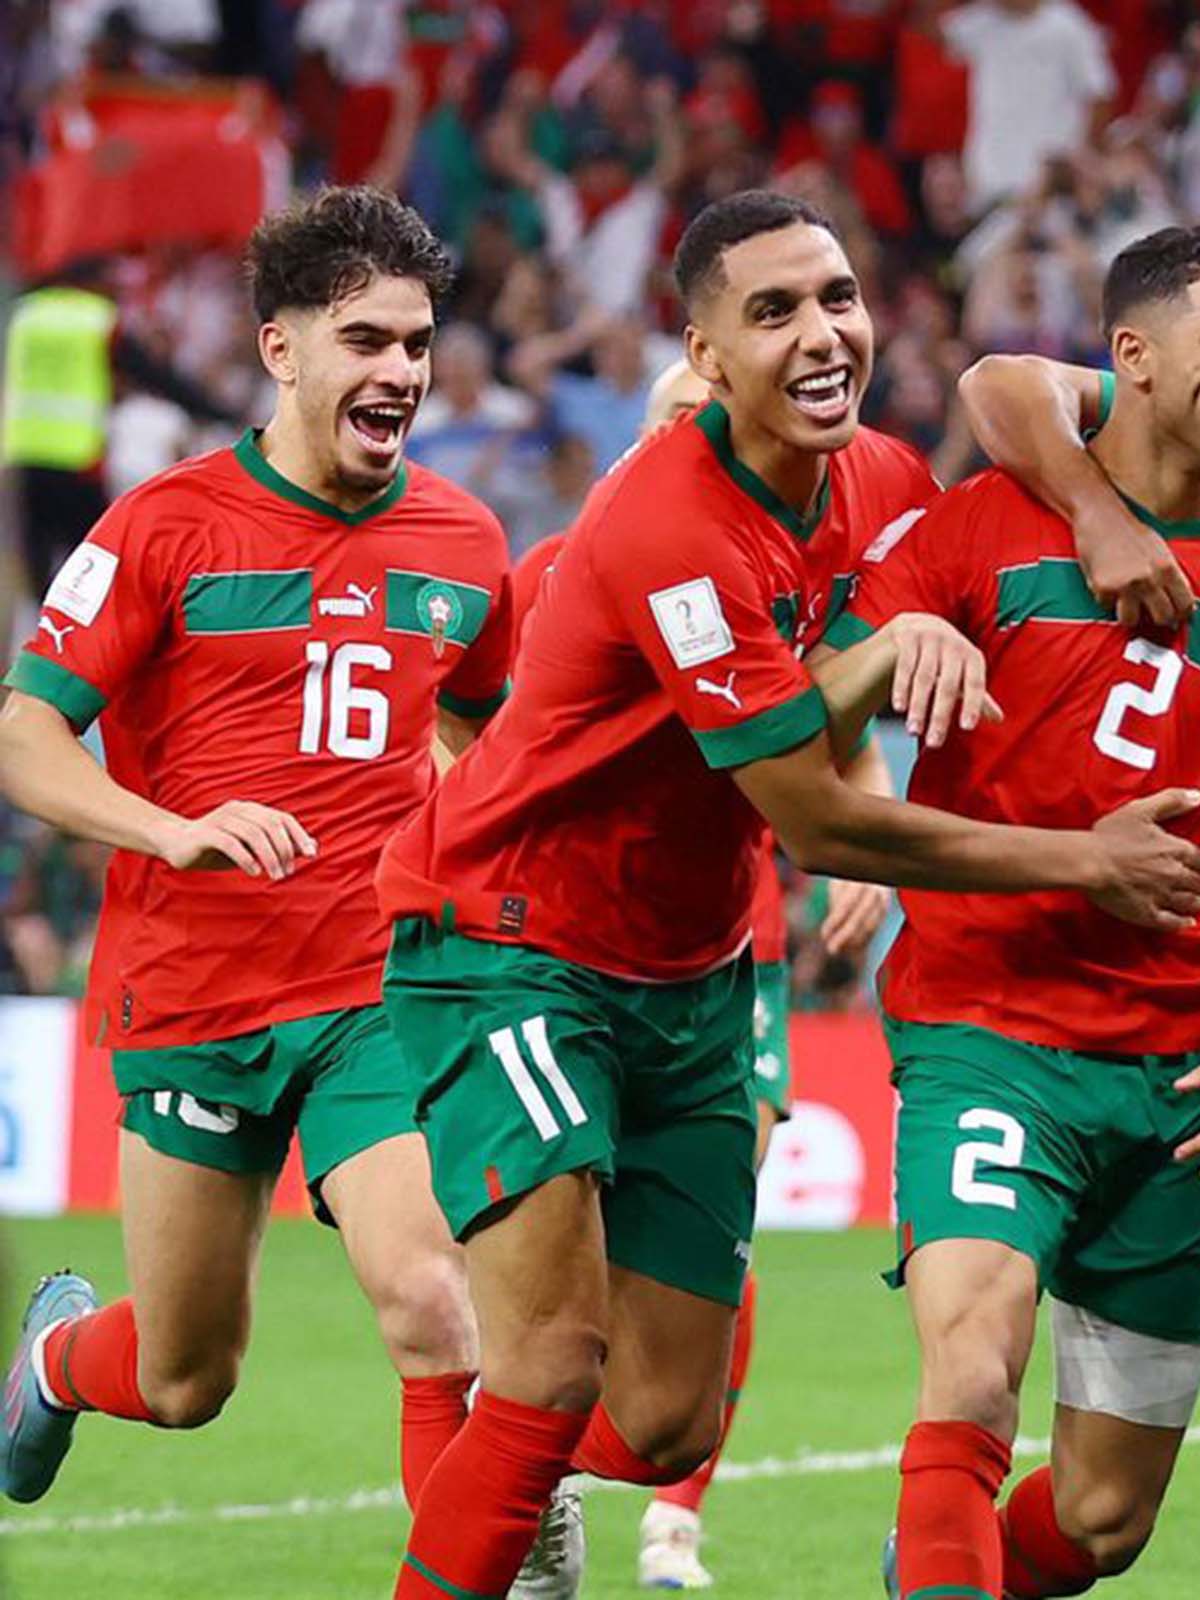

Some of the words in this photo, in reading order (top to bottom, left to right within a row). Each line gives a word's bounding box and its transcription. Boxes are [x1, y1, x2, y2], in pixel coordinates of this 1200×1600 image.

[299, 641, 393, 760] 16
[1093, 638, 1184, 771] 2
[488, 1015, 589, 1142] 11
[952, 1108, 1025, 1211] 2
